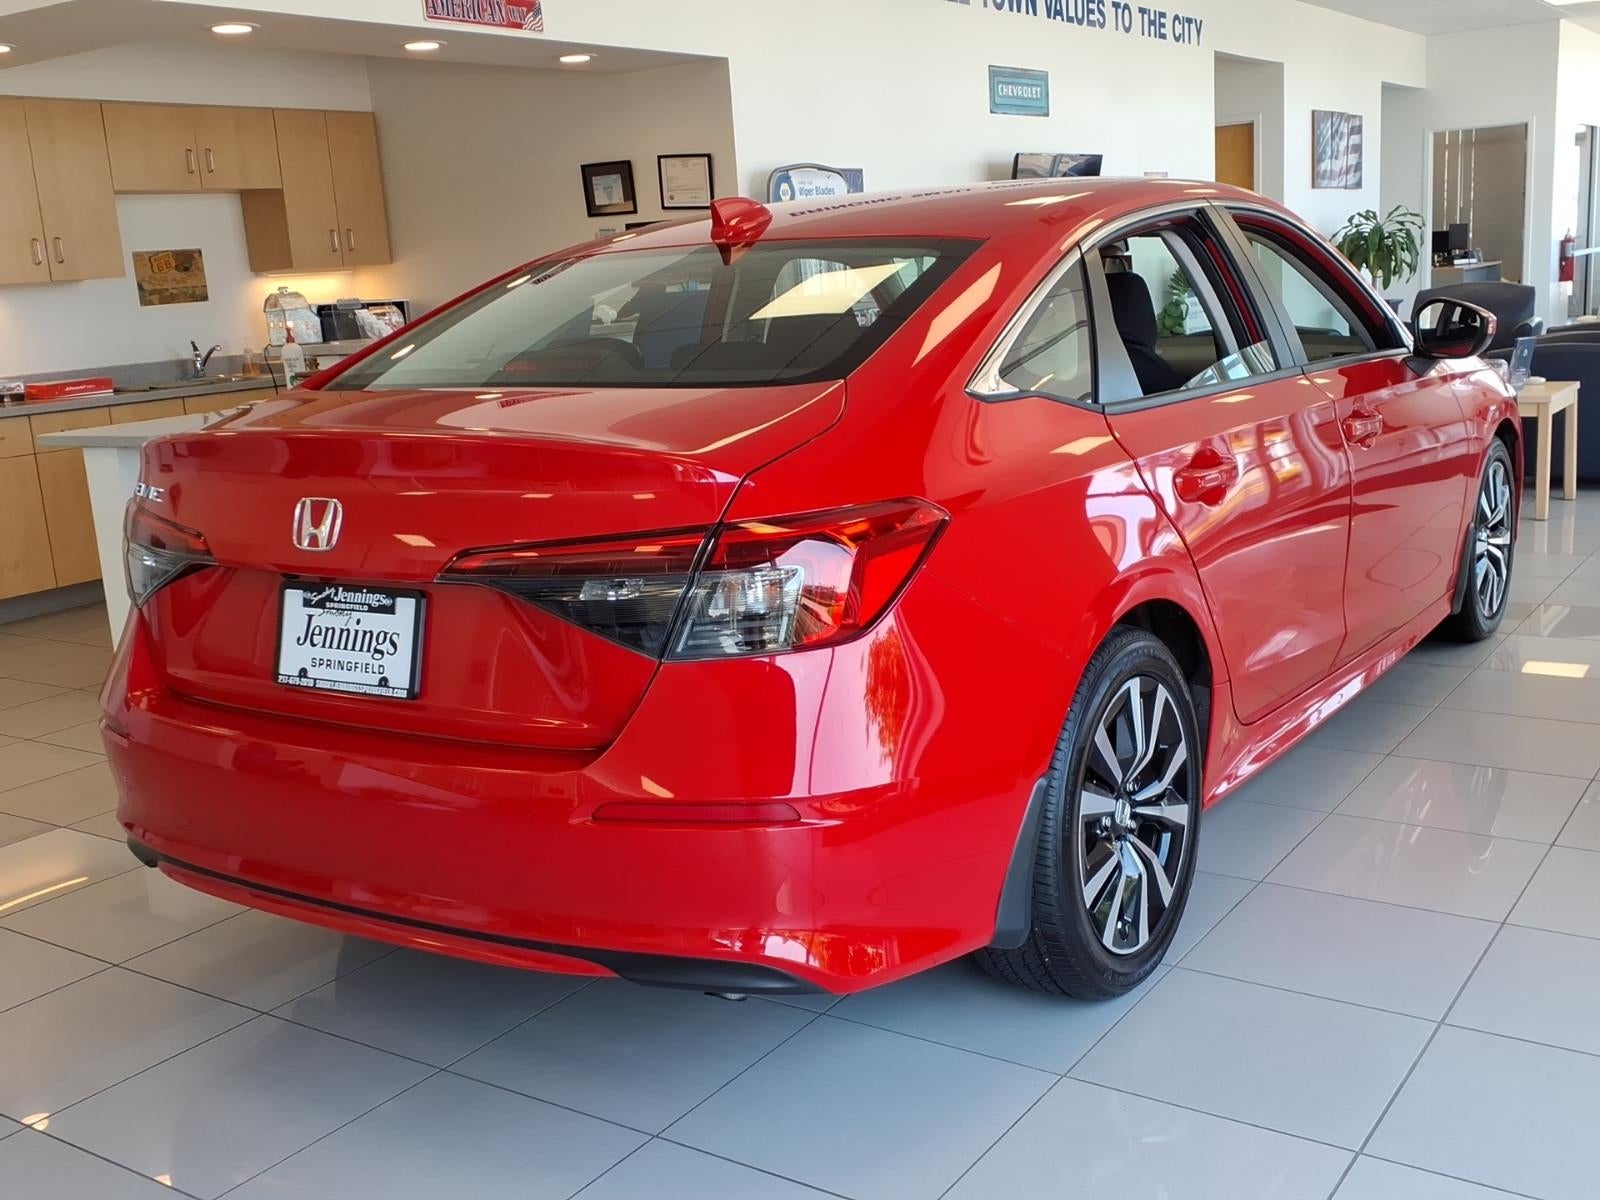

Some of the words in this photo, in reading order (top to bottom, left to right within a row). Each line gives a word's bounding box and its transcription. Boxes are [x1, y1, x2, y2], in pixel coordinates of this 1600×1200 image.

[427, 0, 507, 24] AMERICAN
[1111, 1, 1133, 34] TO
[1138, 6, 1168, 41] THE
[1172, 13, 1204, 46] CITY
[998, 84, 1042, 98] CHEVROLET
[798, 186, 814, 198] Wiper
[815, 186, 836, 196] Blades
[325, 602, 369, 611] SPRINGFIELD
[334, 586, 386, 608] Jennings
[296, 613, 400, 661] Jennings
[310, 657, 386, 675] SPRINGFIELD
